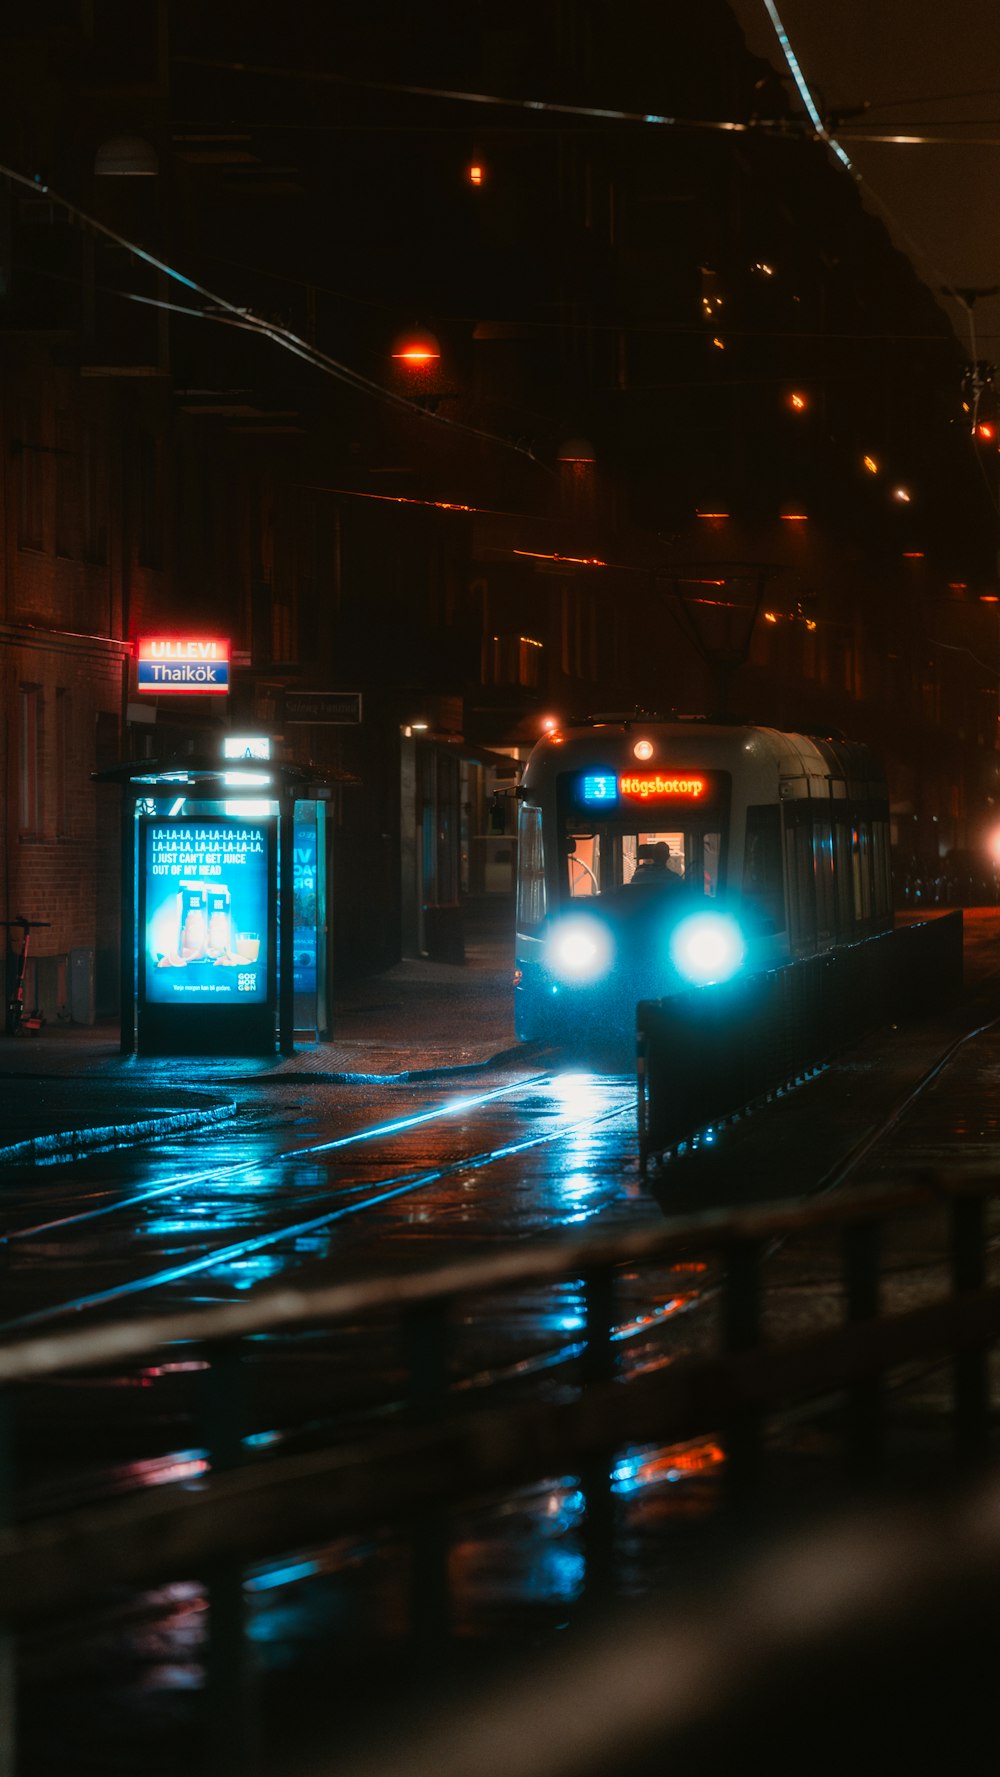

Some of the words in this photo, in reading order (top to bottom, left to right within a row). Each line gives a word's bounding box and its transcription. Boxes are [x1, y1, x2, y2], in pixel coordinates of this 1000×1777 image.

[151, 642, 216, 658] ULLEVI
[151, 665, 216, 681] Thaikök
[594, 777, 606, 798] 3
[621, 777, 702, 796] Högsbotorp
[153, 830, 193, 840] LA-LA-LA,
[196, 830, 263, 841] LA-LA-LA-LA-LA,
[153, 842, 193, 852] LA-LA-LA,
[195, 842, 263, 853] LA-LA-LA-LA-LA,
[153, 854, 156, 863] I
[158, 854, 177, 863] JUST
[179, 854, 203, 863] CAN'T
[206, 854, 221, 863] GET
[223, 854, 246, 864] JUICE
[153, 865, 169, 874] OUT
[171, 866, 182, 874] OF
[184, 866, 197, 875] MY
[199, 866, 221, 875] HEAD
